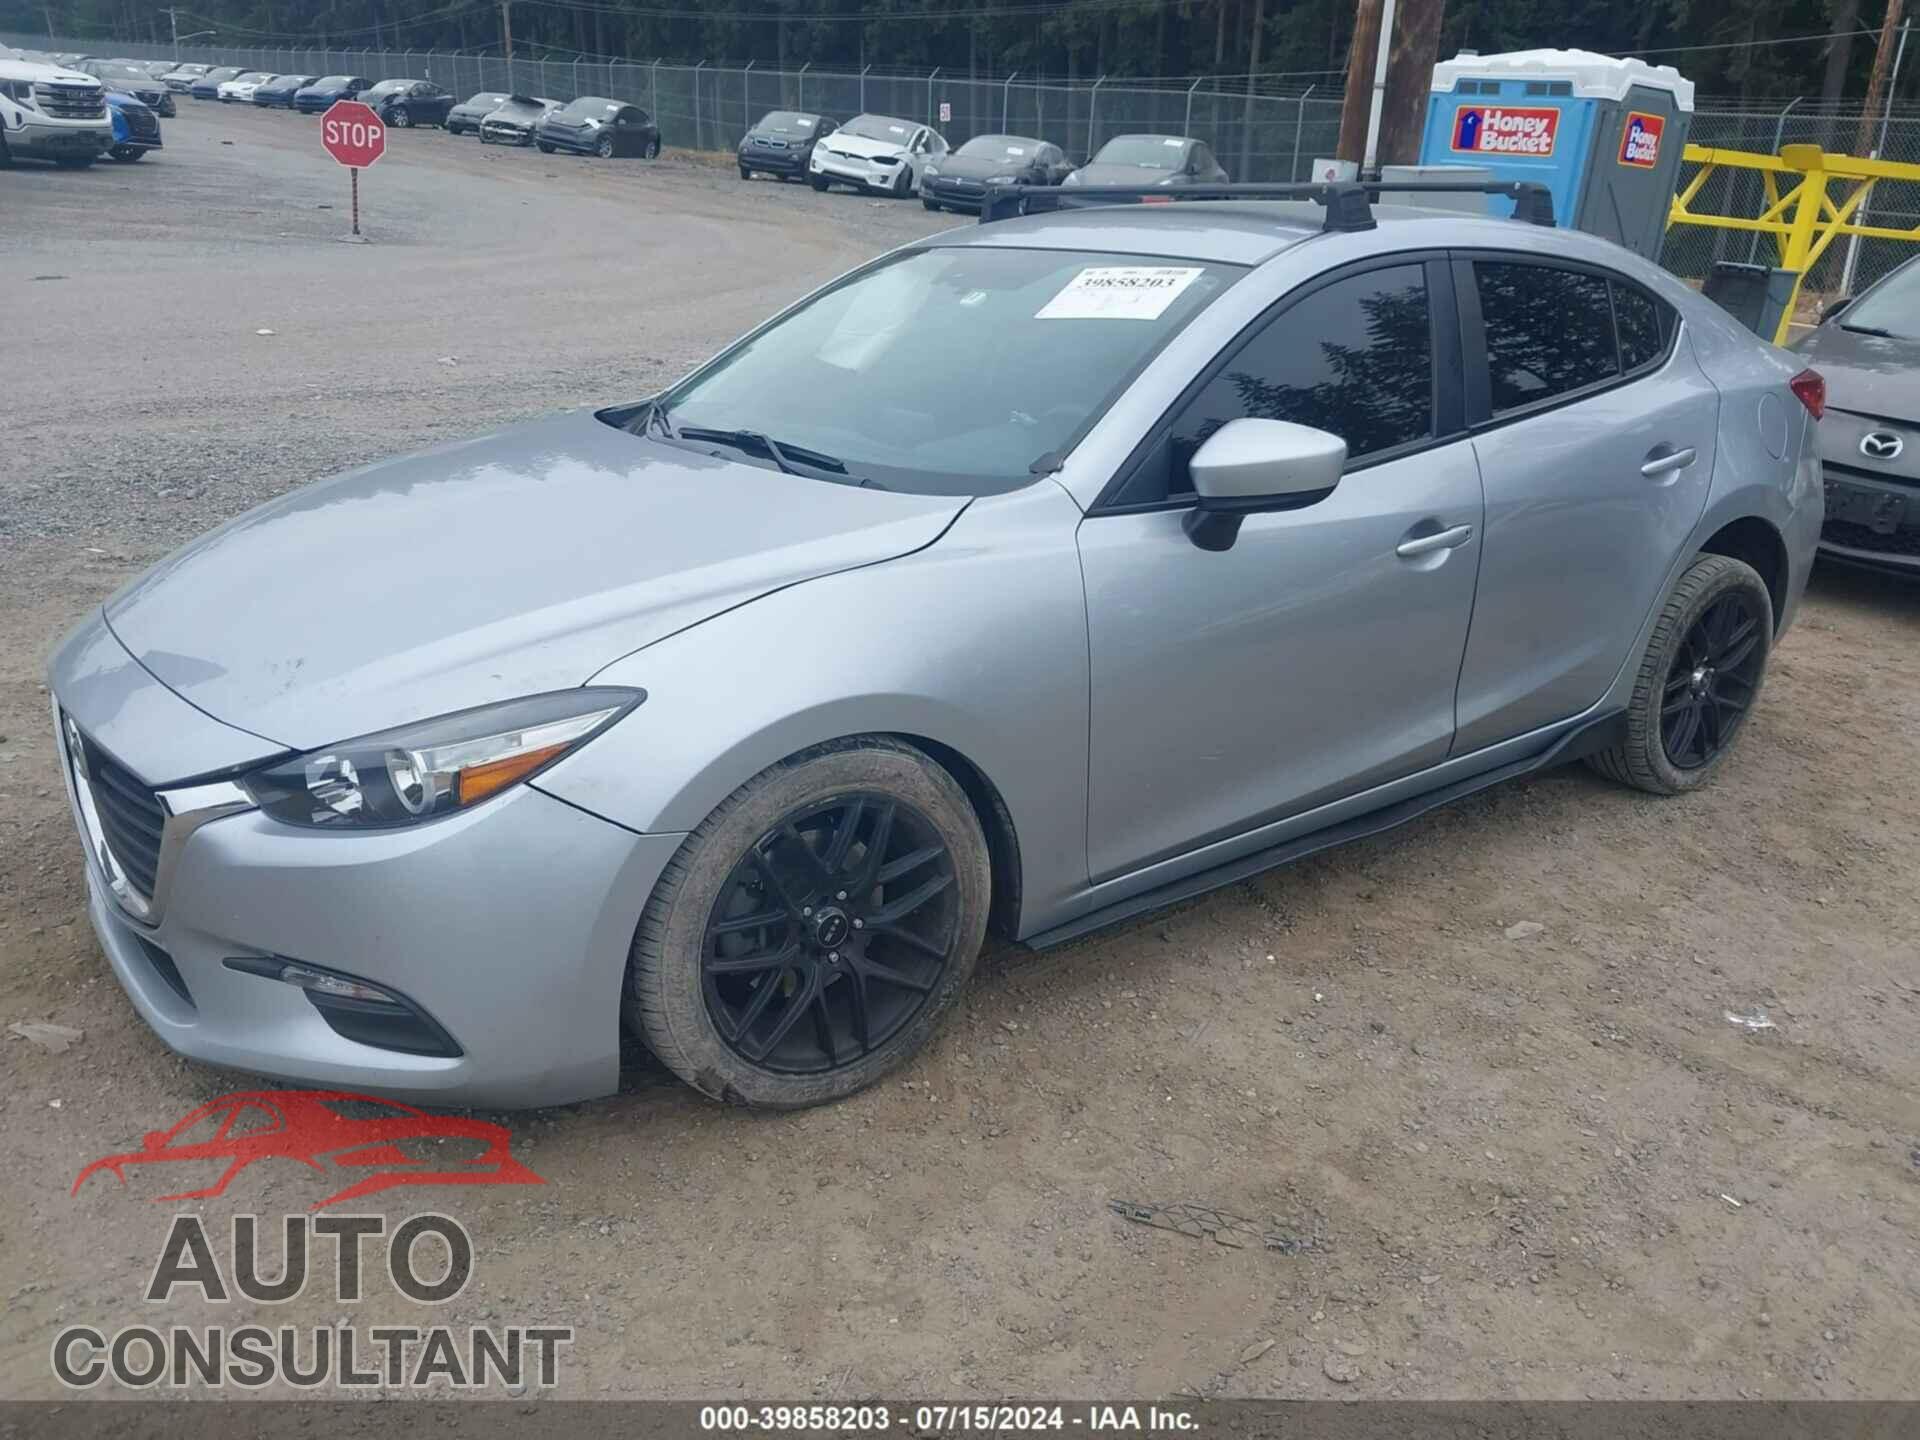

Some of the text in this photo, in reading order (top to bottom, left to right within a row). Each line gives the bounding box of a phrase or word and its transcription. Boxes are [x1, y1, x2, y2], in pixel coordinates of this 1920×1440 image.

[326, 120, 381, 148] STOP
[1482, 109, 1550, 137] Honey
[1479, 130, 1552, 152] Bucket
[1084, 278, 1176, 288] 39858203
